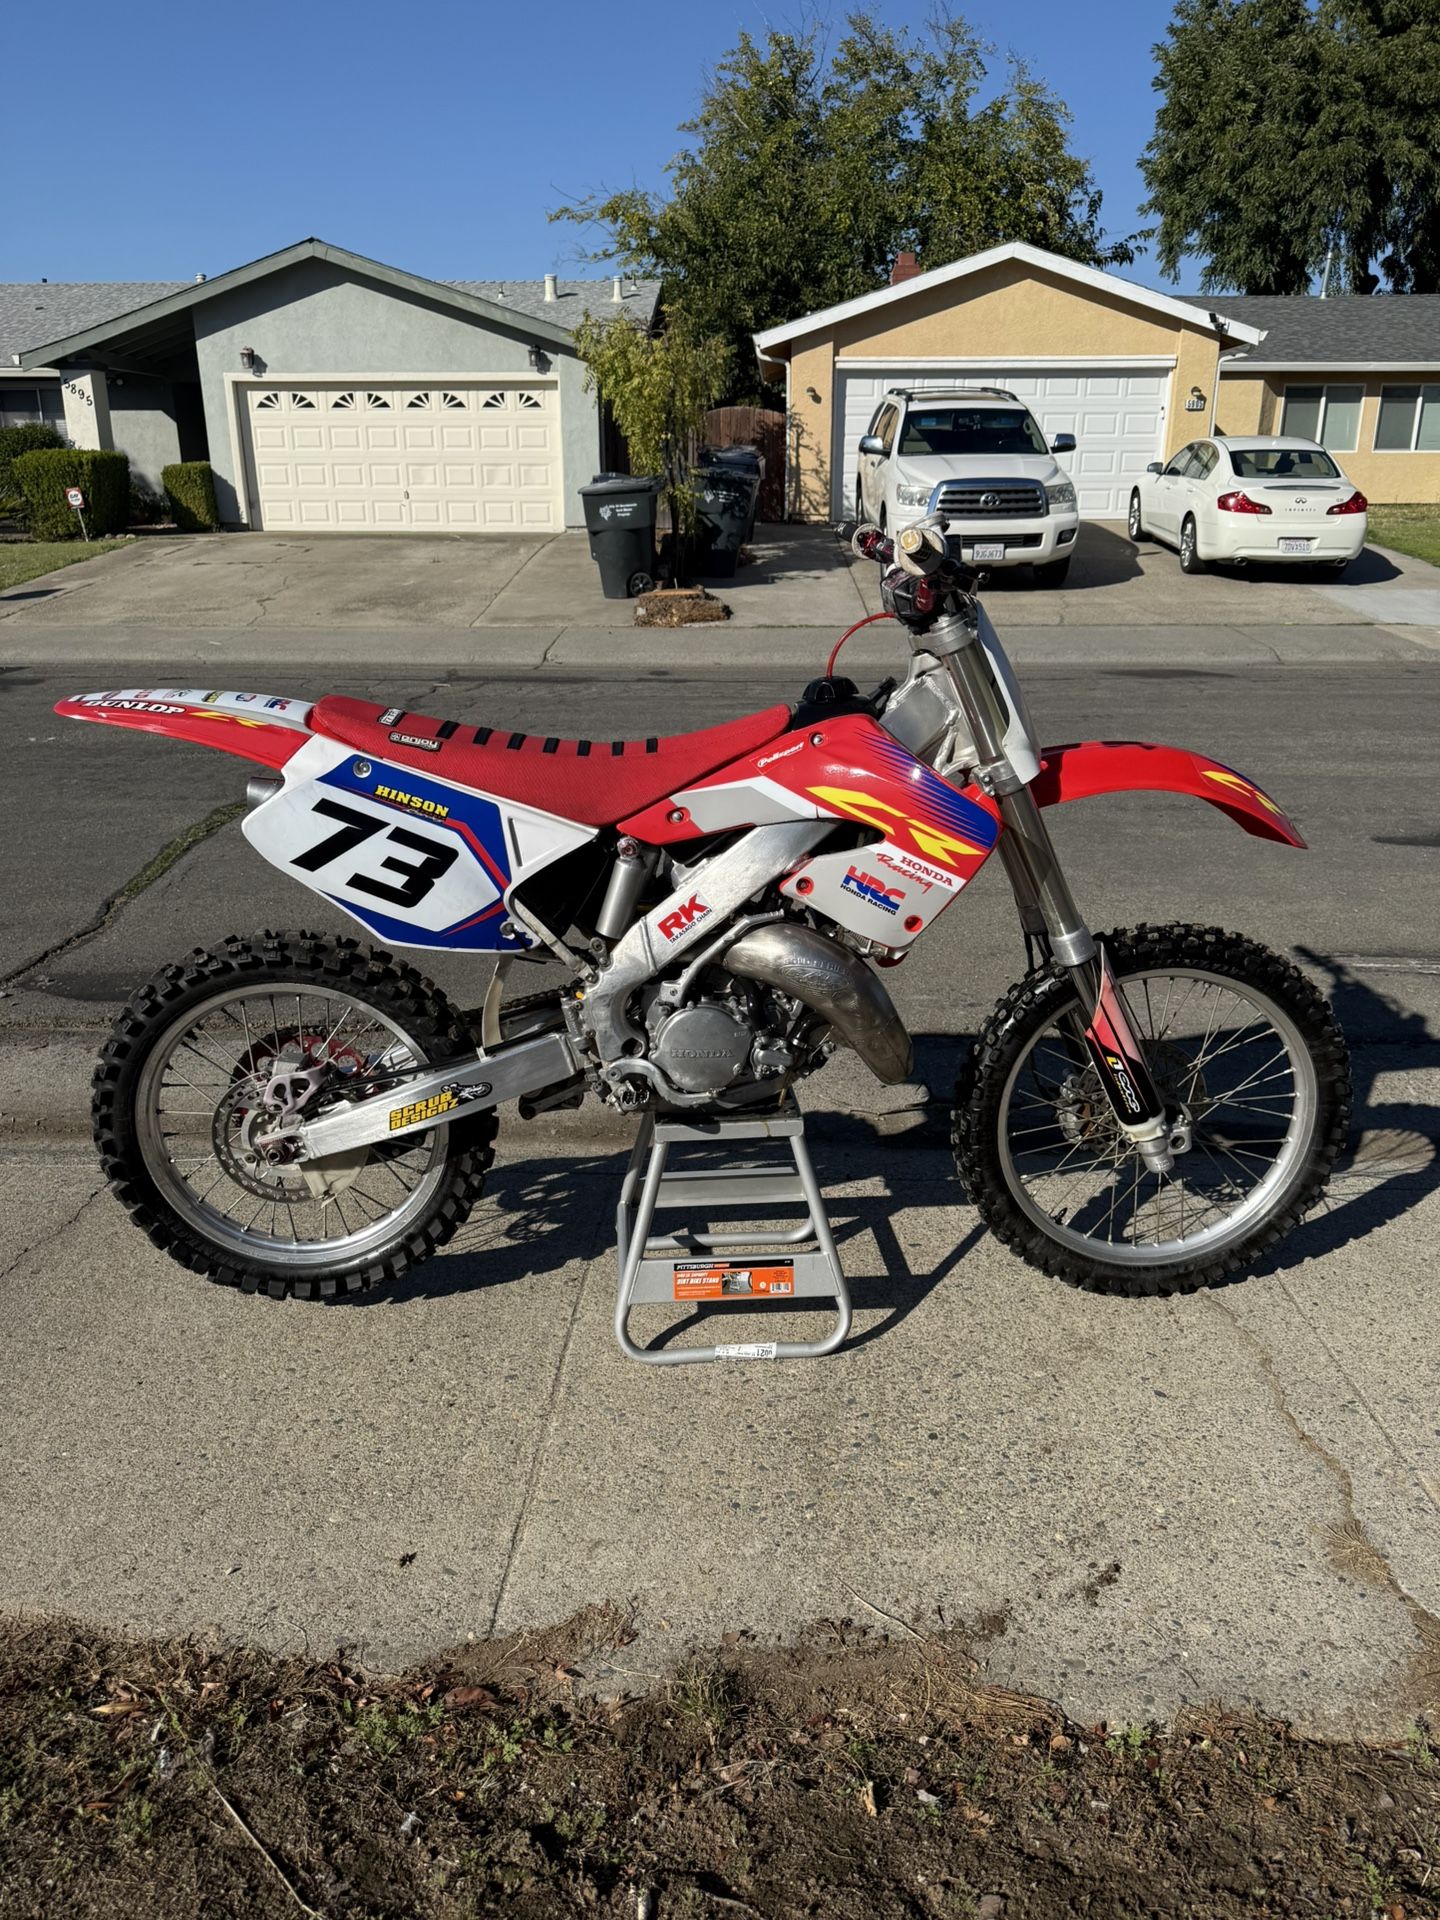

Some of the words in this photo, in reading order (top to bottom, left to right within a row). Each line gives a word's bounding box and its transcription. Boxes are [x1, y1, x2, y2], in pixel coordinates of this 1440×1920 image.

[64, 378, 93, 406] 5895
[82, 700, 185, 715] DUNLOP
[375, 784, 449, 817] HINSON
[289, 798, 459, 908] 73
[876, 853, 934, 894] Racing
[900, 856, 953, 887] HONDA
[840, 884, 867, 900] HONDA
[867, 896, 898, 916] RACING
[842, 865, 907, 911] HRC
[657, 893, 709, 940] RK
[669, 921, 697, 943] TAKASAGO
[696, 908, 713, 922] CHAIN
[671, 1048, 735, 1059] HONDA
[390, 1090, 454, 1120] SCRUB
